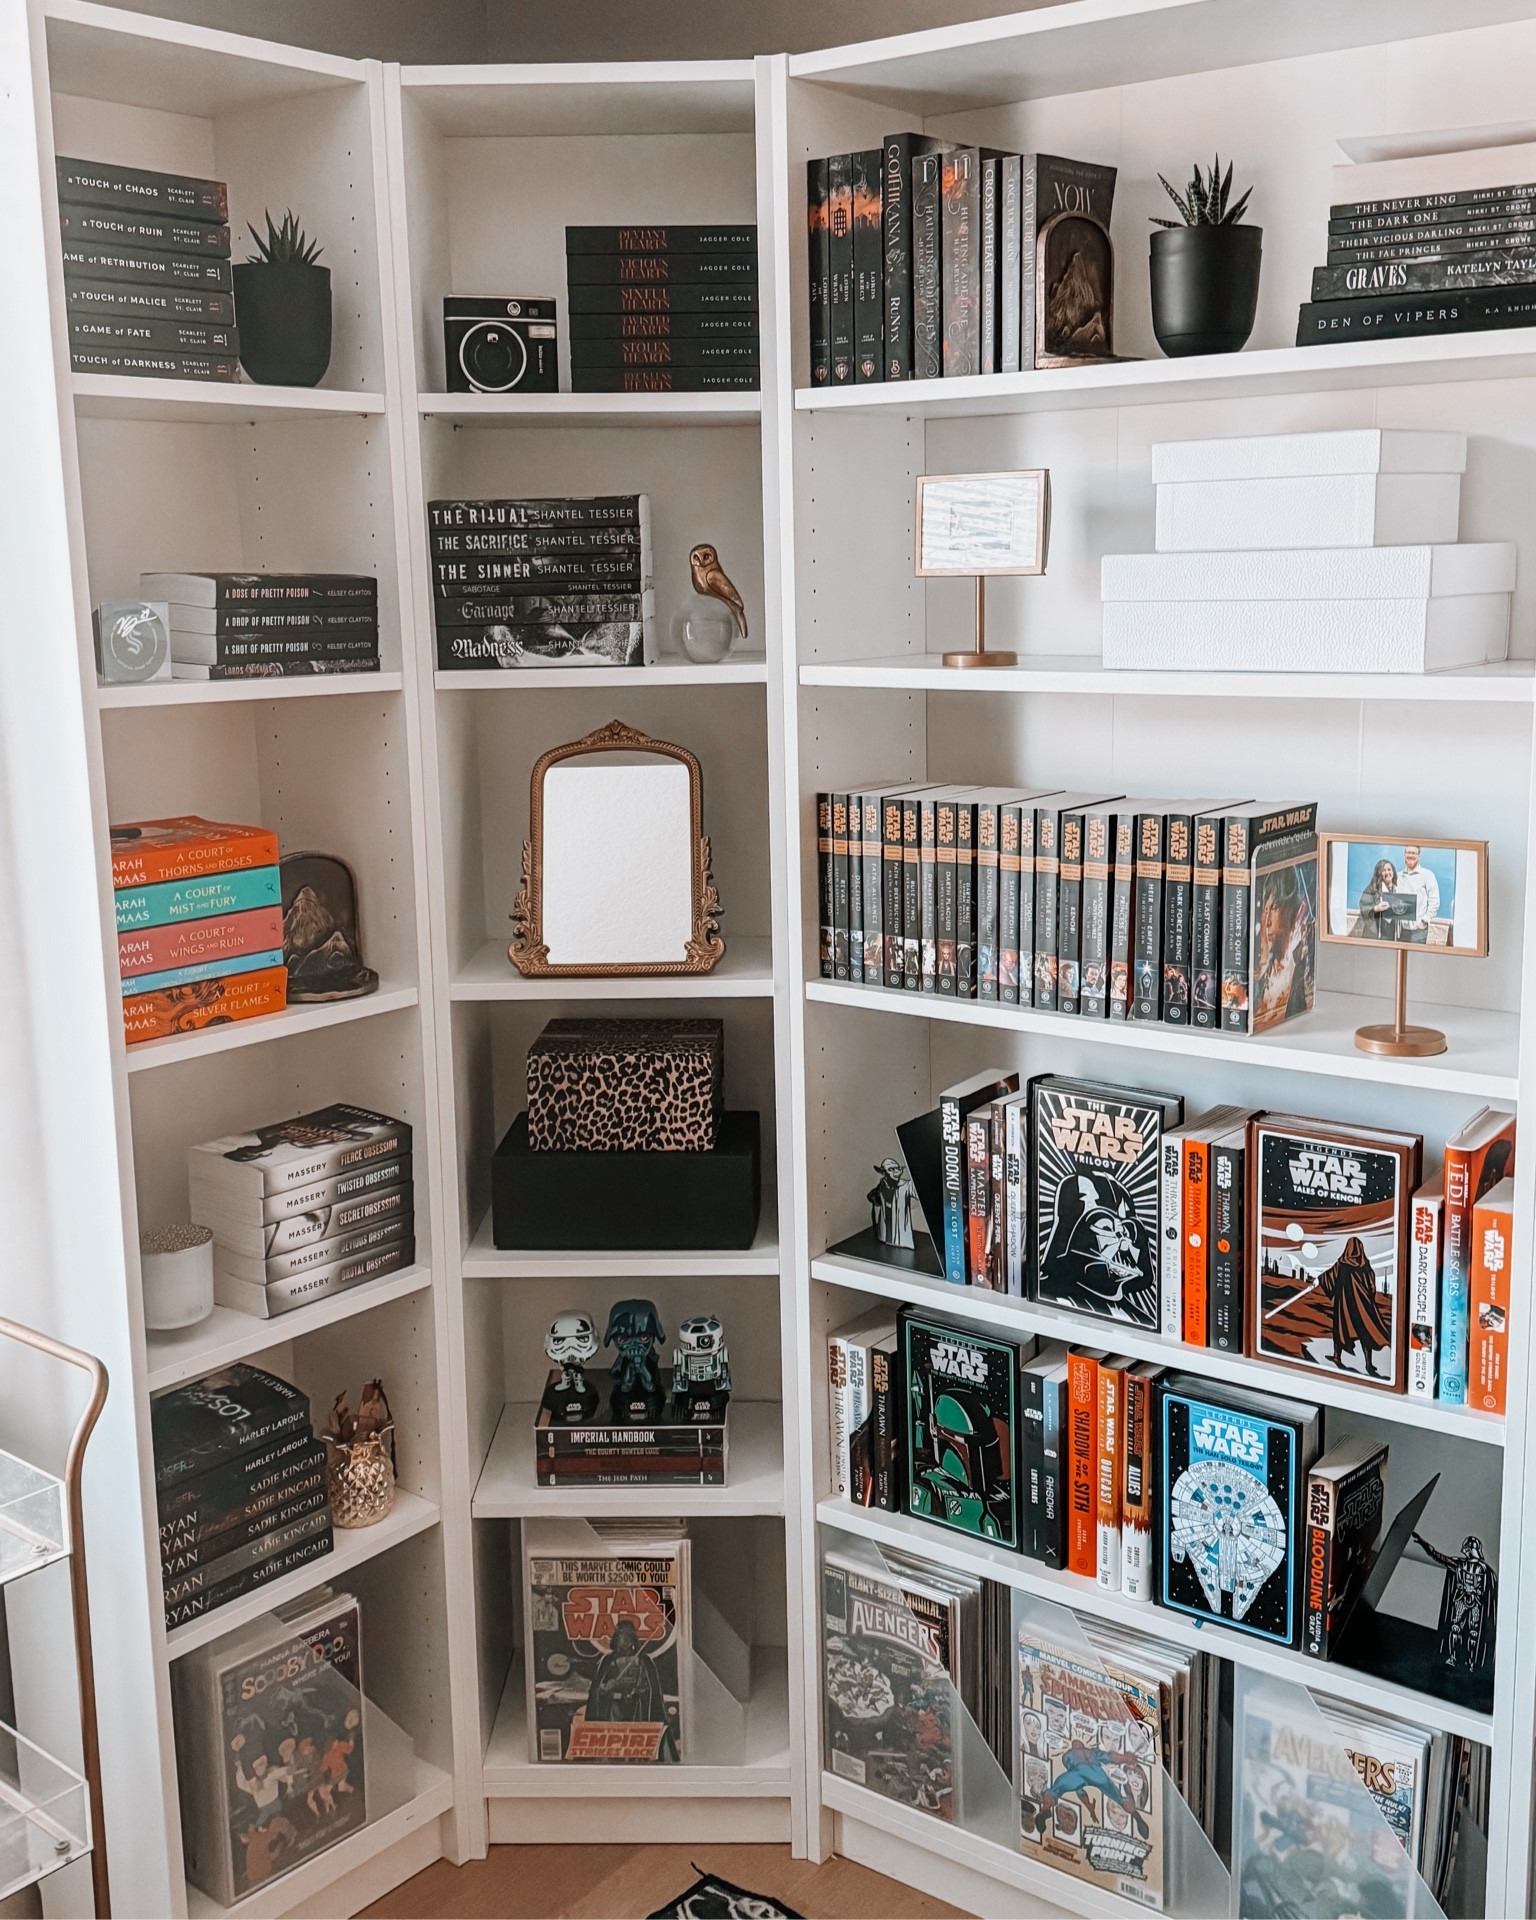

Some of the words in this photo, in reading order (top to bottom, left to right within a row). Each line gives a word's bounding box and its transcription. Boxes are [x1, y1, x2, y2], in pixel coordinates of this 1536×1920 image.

[75, 176, 109, 189] TOUCH
[125, 184, 158, 197] CHAOS
[984, 168, 992, 209] CROSS
[985, 212, 992, 226] MY
[1355, 205, 1378, 214] THE
[1383, 200, 1421, 211] NEVER
[1426, 195, 1456, 206] KING
[1350, 221, 1373, 230] THE
[1378, 216, 1410, 227] DARK
[1414, 212, 1439, 223] ONE
[1340, 238, 1369, 248] THEIR
[1373, 233, 1414, 243] VICIOUS
[1418, 227, 1463, 239] DARLING
[984, 229, 992, 276] HEART
[1356, 252, 1374, 260] THE
[1378, 250, 1396, 258] FAE
[1400, 245, 1441, 256] PRINCES
[1346, 265, 1407, 290] GRAVES
[80, 292, 115, 302] TOUCH
[130, 296, 167, 307] MALICE
[984, 283, 992, 308] ROXY
[890, 297, 900, 343] RUNYX
[983, 311, 991, 345] SLOANE
[1318, 318, 1351, 329] DEN
[1363, 315, 1384, 326] OF
[1395, 308, 1459, 322] VIPERS
[433, 510, 463, 524] THE
[534, 510, 584, 520] SHANTEL
[589, 509, 633, 519] TESSIER
[438, 537, 459, 550] THE
[466, 534, 528, 549] SACRIFICE
[535, 536, 585, 546] SHANTEL
[590, 535, 634, 545] TESSIER
[439, 565, 467, 580] THE
[478, 564, 530, 578] SINNER
[538, 564, 586, 574] SHANTEL
[590, 562, 632, 573] TESSIER
[225, 589, 229, 598] A
[232, 589, 248, 598] DOSE
[251, 589, 258, 598] OF
[261, 588, 284, 598] PRETTY
[286, 588, 309, 598] POISON
[225, 618, 230, 627] A
[232, 616, 248, 627] DROP
[251, 616, 259, 626] OF
[262, 616, 285, 626] PRETTY
[286, 615, 309, 625] POISON
[451, 635, 524, 659] Madness
[1171, 820, 1179, 859] WARS
[1178, 821, 1188, 859] STAR
[158, 860, 203, 878] THORNS
[218, 856, 252, 868] ROSES
[177, 853, 184, 862] A
[188, 847, 224, 862] COURT
[114, 872, 147, 885] MAAS
[193, 1001, 227, 1017] SILVER
[230, 995, 270, 1011] FLAMES
[941, 1102, 952, 1141] WARS
[1087, 1102, 1106, 1112] THE
[949, 1102, 960, 1143] STAR
[1052, 1107, 1142, 1141] STAR
[287, 1162, 326, 1180] MASSERY
[340, 1150, 362, 1167] FIERCE
[364, 1138, 398, 1158] OBSESSION
[1052, 1127, 1143, 1163] WARS
[1303, 1143, 1353, 1158] LEGENDS
[946, 1146, 959, 1191] DOOKU
[1074, 1154, 1116, 1170] TRILOGY
[1289, 1152, 1366, 1180] STAR
[286, 1190, 326, 1208] MASSERY
[337, 1176, 364, 1195] TWISTED
[365, 1166, 399, 1185] OBSESSION
[1289, 1167, 1366, 1196] WARS
[1293, 1185, 1316, 1195] TALES
[1318, 1189, 1329, 1197] OF
[1330, 1190, 1362, 1204] KENOBI
[1451, 1163, 1464, 1208] JEDI
[950, 1192, 958, 1214] JEDI
[950, 1217, 958, 1239] LOST
[1415, 1206, 1425, 1244] WARS
[1424, 1208, 1434, 1244] STAR
[1452, 1214, 1461, 1258] BATTLE
[1419, 1246, 1428, 1276] DARK
[1450, 1260, 1460, 1298] SCARS
[1416, 1278, 1427, 1322] DISCIPLE
[930, 1342, 988, 1369] STAR
[930, 1354, 988, 1383] WARS
[1105, 1379, 1115, 1416] STAR
[239, 1425, 271, 1445] HARLEY
[272, 1411, 304, 1431] LAROUX
[571, 1432, 609, 1443] IMPERIAL
[612, 1432, 655, 1443] HANDBOOK
[1074, 1408, 1090, 1462] SHADOW
[1083, 1464, 1088, 1476] OF
[1104, 1417, 1115, 1454] WARS
[1194, 1418, 1263, 1448] STAR
[1194, 1432, 1263, 1462] WARS
[1101, 1458, 1112, 1505] OUTCAST
[1128, 1465, 1141, 1497] ALLIES
[1074, 1480, 1090, 1513] SITH
[1310, 1484, 1320, 1526] WARS
[1319, 1485, 1330, 1526] STAR
[248, 1514, 277, 1535] SADIE
[280, 1494, 324, 1520] KINCAID
[561, 1562, 579, 1571] THIS
[581, 1562, 613, 1571] MARVEL
[616, 1562, 642, 1571] COMIC
[644, 1561, 671, 1572] COULD
[563, 1573, 574, 1582] BE
[576, 1573, 606, 1582] WORTH
[608, 1573, 634, 1582] $2500
[637, 1573, 647, 1582] TO
[649, 1573, 669, 1583] YOU!
[1310, 1529, 1324, 1610] BLOODLINE
[563, 1588, 665, 1614] STAR
[852, 1600, 941, 1660] AVENGERS
[1039, 1651, 1070, 1669] MARVEL
[1071, 1663, 1104, 1682] COMICS
[572, 1734, 659, 1747] EMPIRE
[1085, 1834, 1147, 1855] TURNING
[1090, 1848, 1134, 1862] POINT
